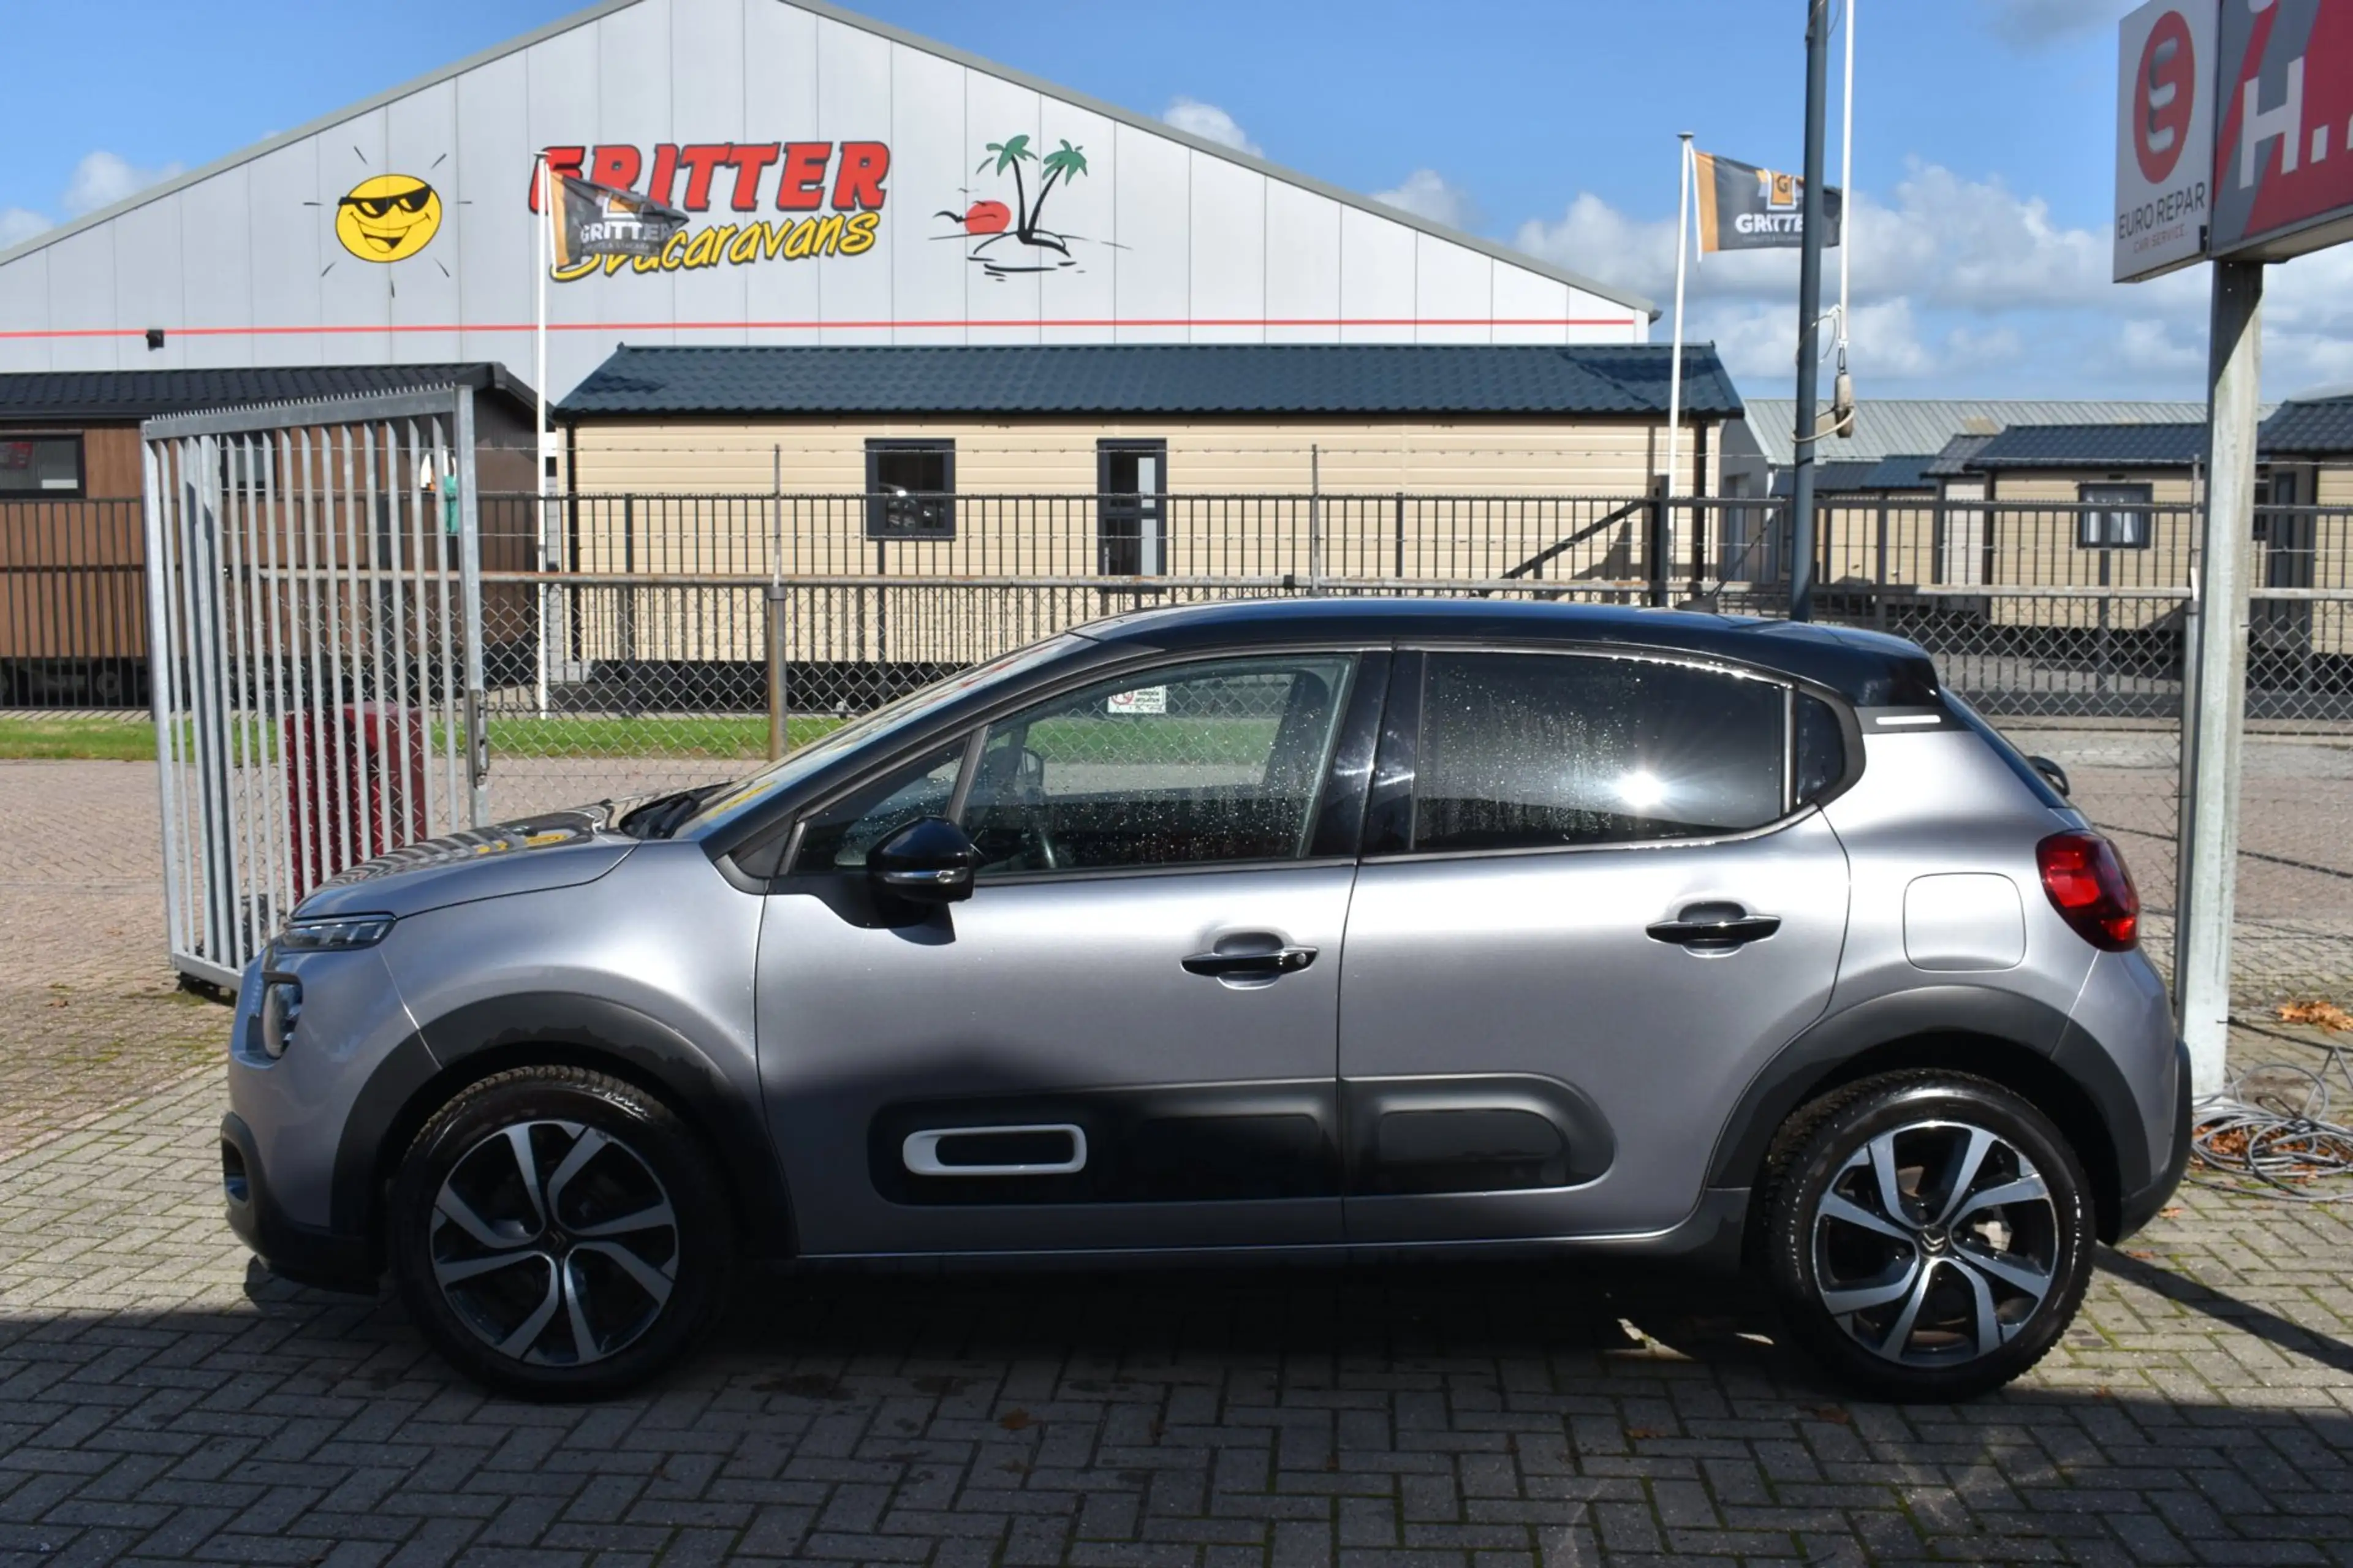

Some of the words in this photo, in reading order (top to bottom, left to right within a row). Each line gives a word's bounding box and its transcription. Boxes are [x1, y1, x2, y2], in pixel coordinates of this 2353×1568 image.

[2240, 56, 2353, 190] H.
[1735, 213, 1803, 233] GRITTE
[2118, 203, 2154, 240] EURO
[2156, 181, 2205, 226] REPAR
